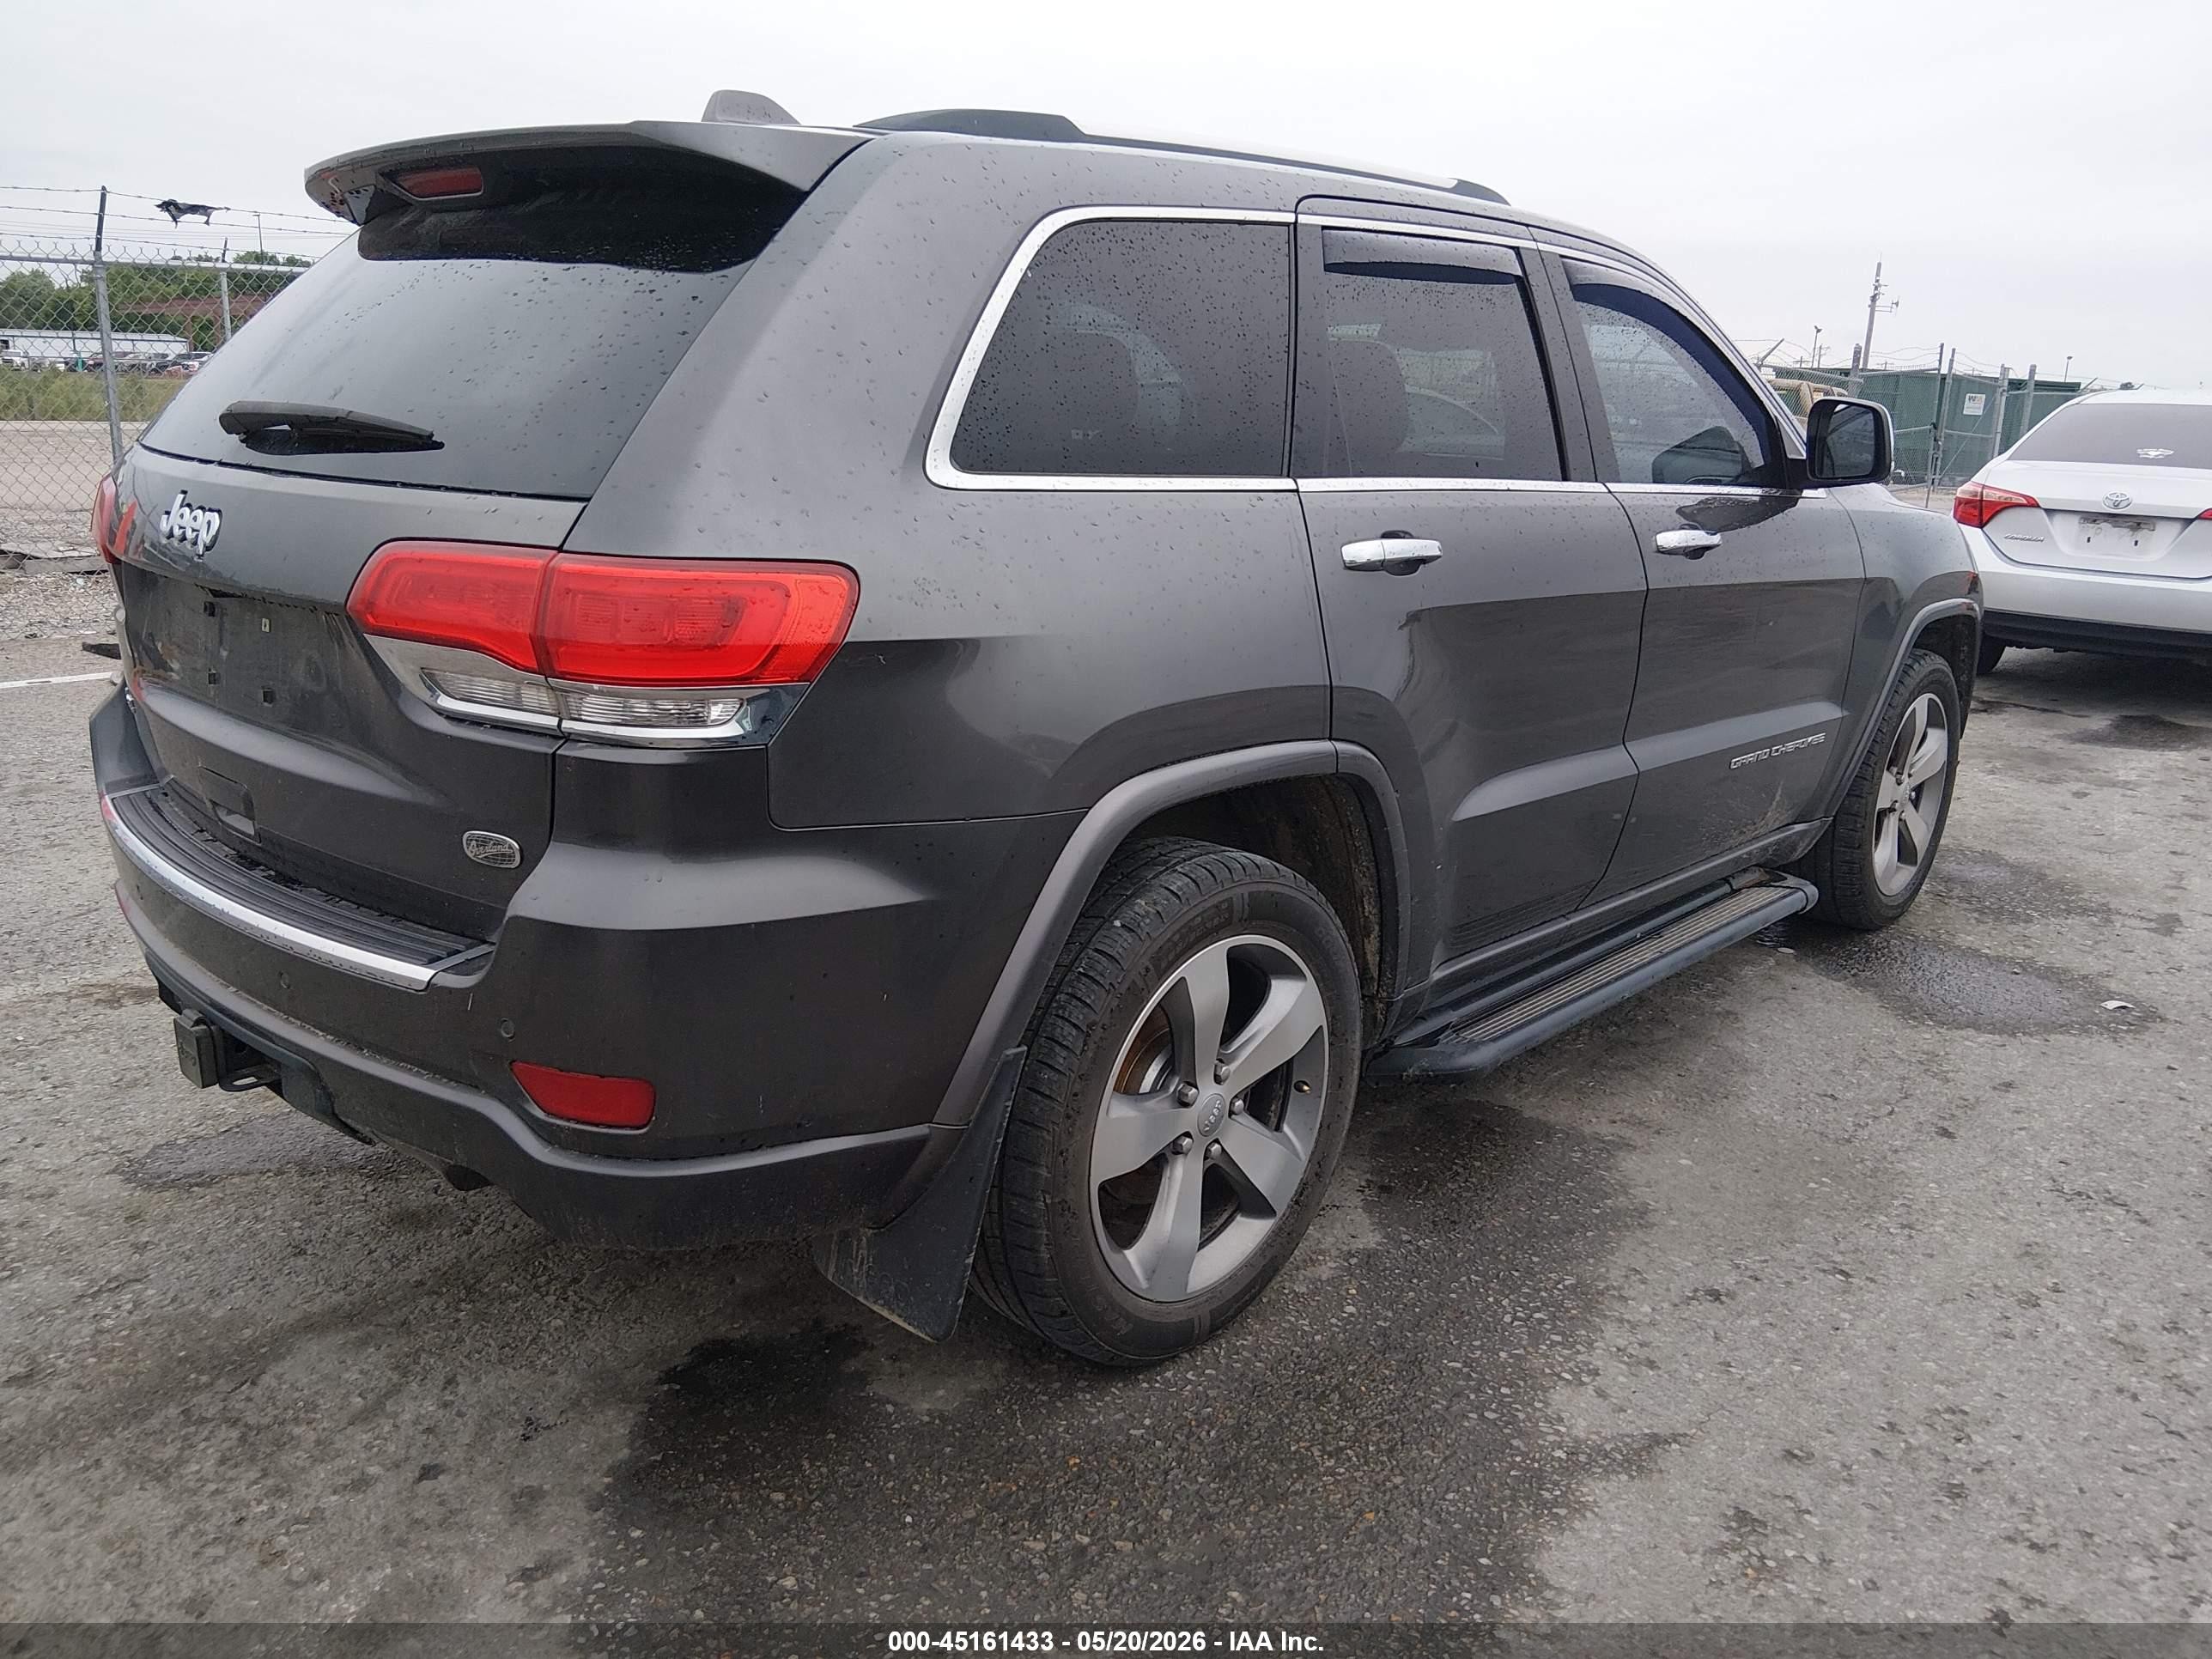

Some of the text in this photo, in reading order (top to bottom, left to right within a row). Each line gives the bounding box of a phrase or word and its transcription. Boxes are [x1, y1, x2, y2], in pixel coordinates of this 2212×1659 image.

[160, 489, 222, 556] Jeep
[1729, 732, 1826, 769] GRAND CHEROKEE
[467, 841, 514, 857] Overland
